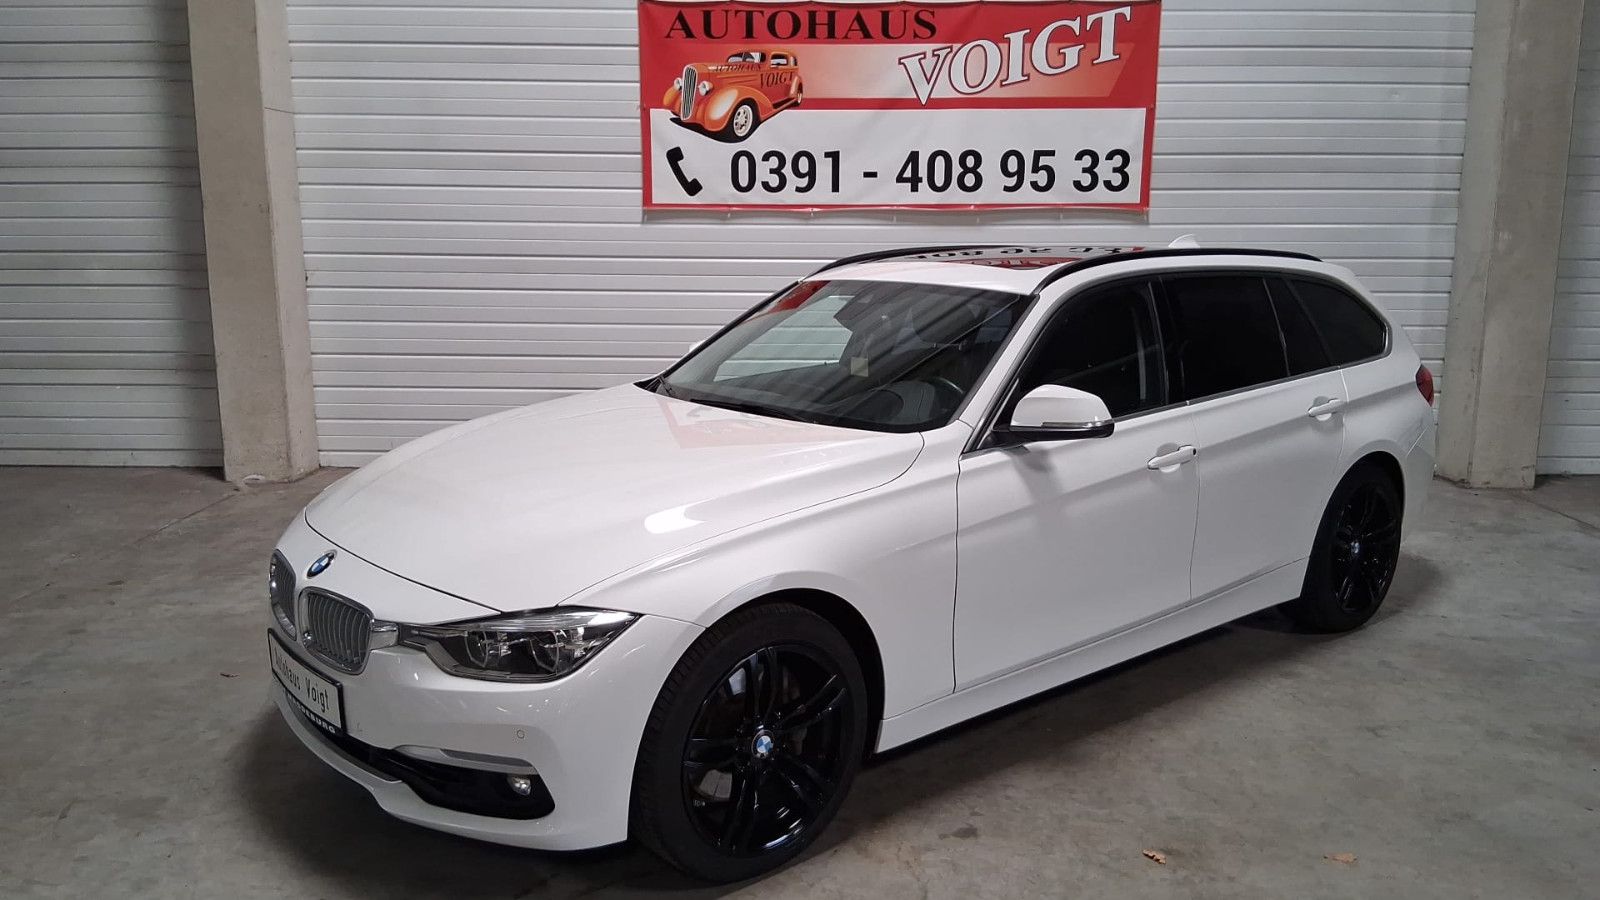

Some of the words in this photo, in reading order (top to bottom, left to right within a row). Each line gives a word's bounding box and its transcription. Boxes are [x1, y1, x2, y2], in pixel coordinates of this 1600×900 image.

[664, 9, 937, 40] AUTOHAUS
[898, 6, 1131, 106] VOIGT
[760, 71, 794, 89] VOIGT
[730, 149, 841, 193] 0391
[896, 149, 983, 193] 408
[1000, 149, 1056, 193] 95
[1072, 149, 1131, 193] 33
[305, 676, 330, 713] Voigt
